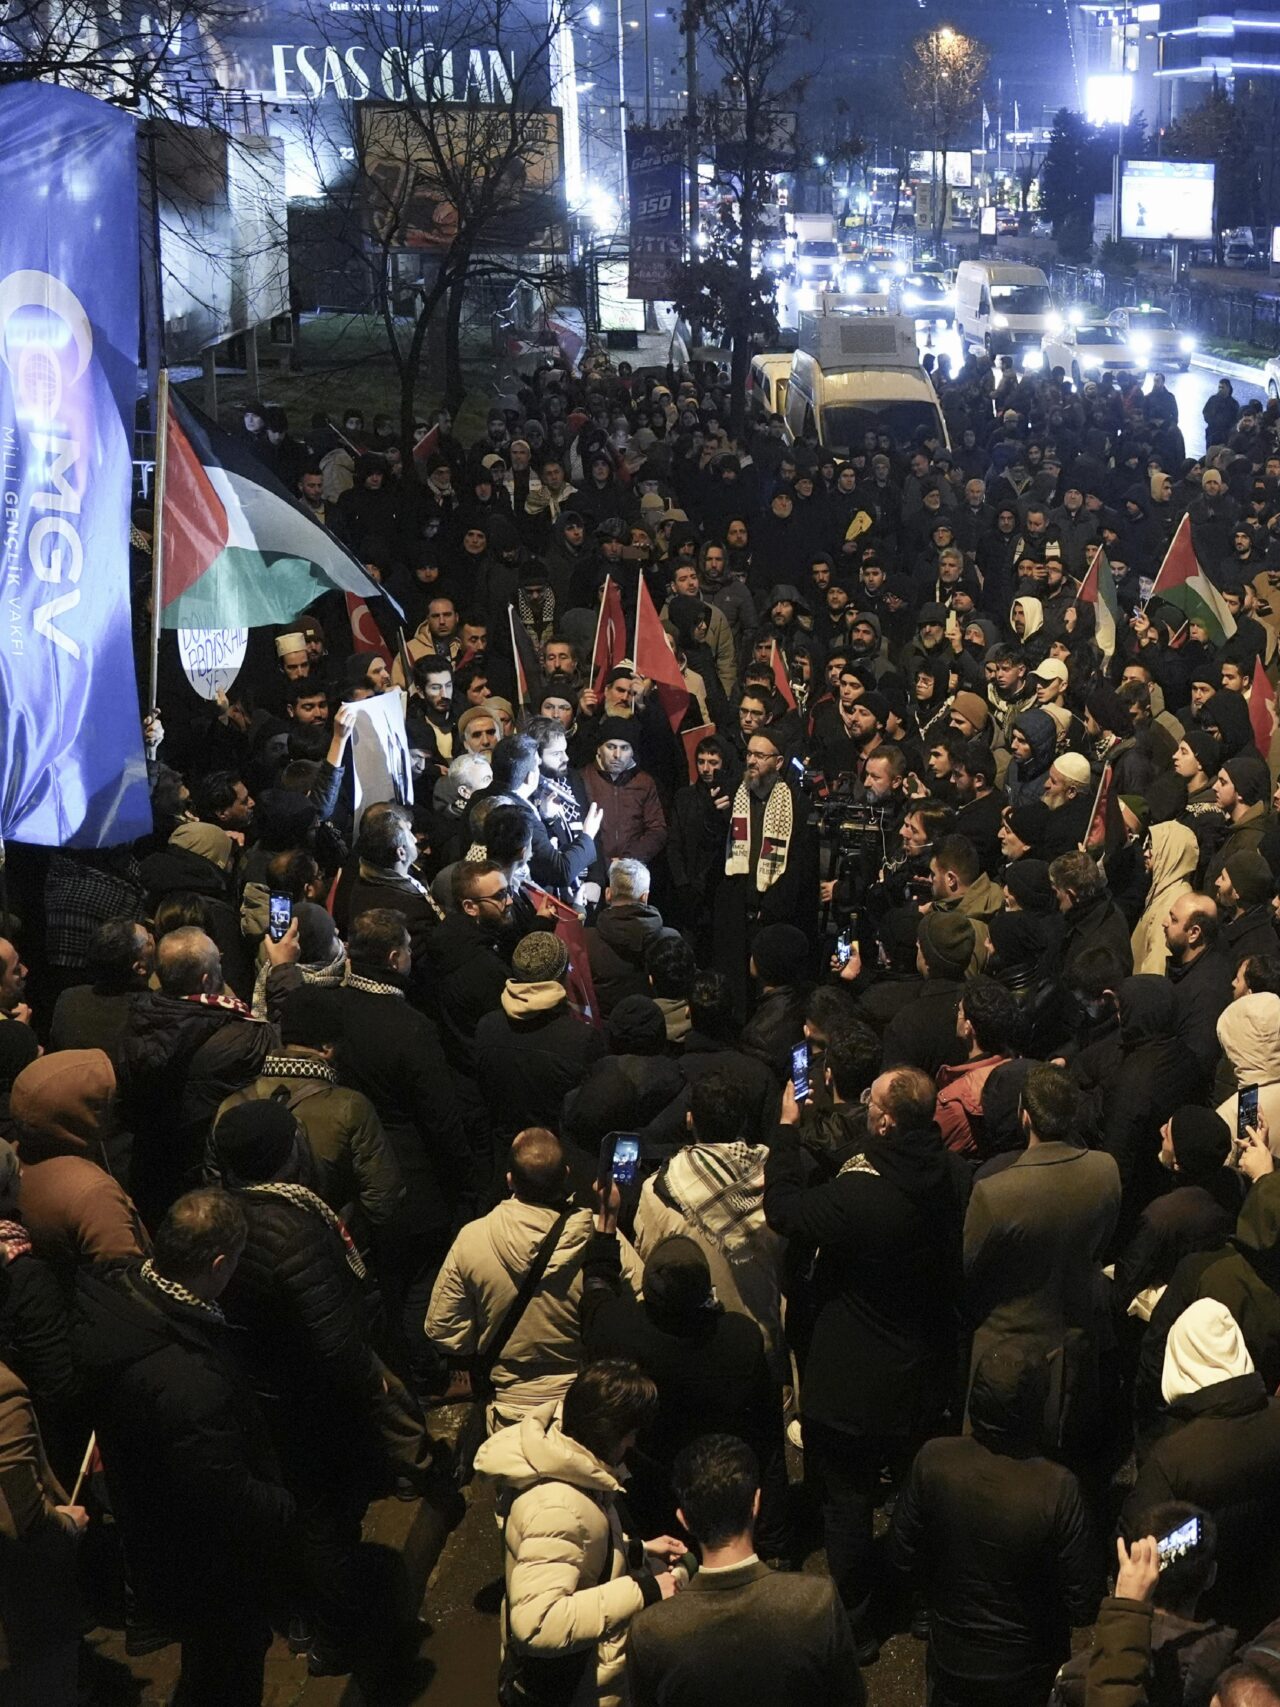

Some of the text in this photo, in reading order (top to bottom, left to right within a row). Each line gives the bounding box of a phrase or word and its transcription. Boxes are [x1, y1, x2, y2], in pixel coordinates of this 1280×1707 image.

[271, 44, 371, 102] ESAS
[4, 491, 22, 586] GENÇLİK
[28, 431, 84, 661] MGV
[9, 597, 24, 657] VAKFI
